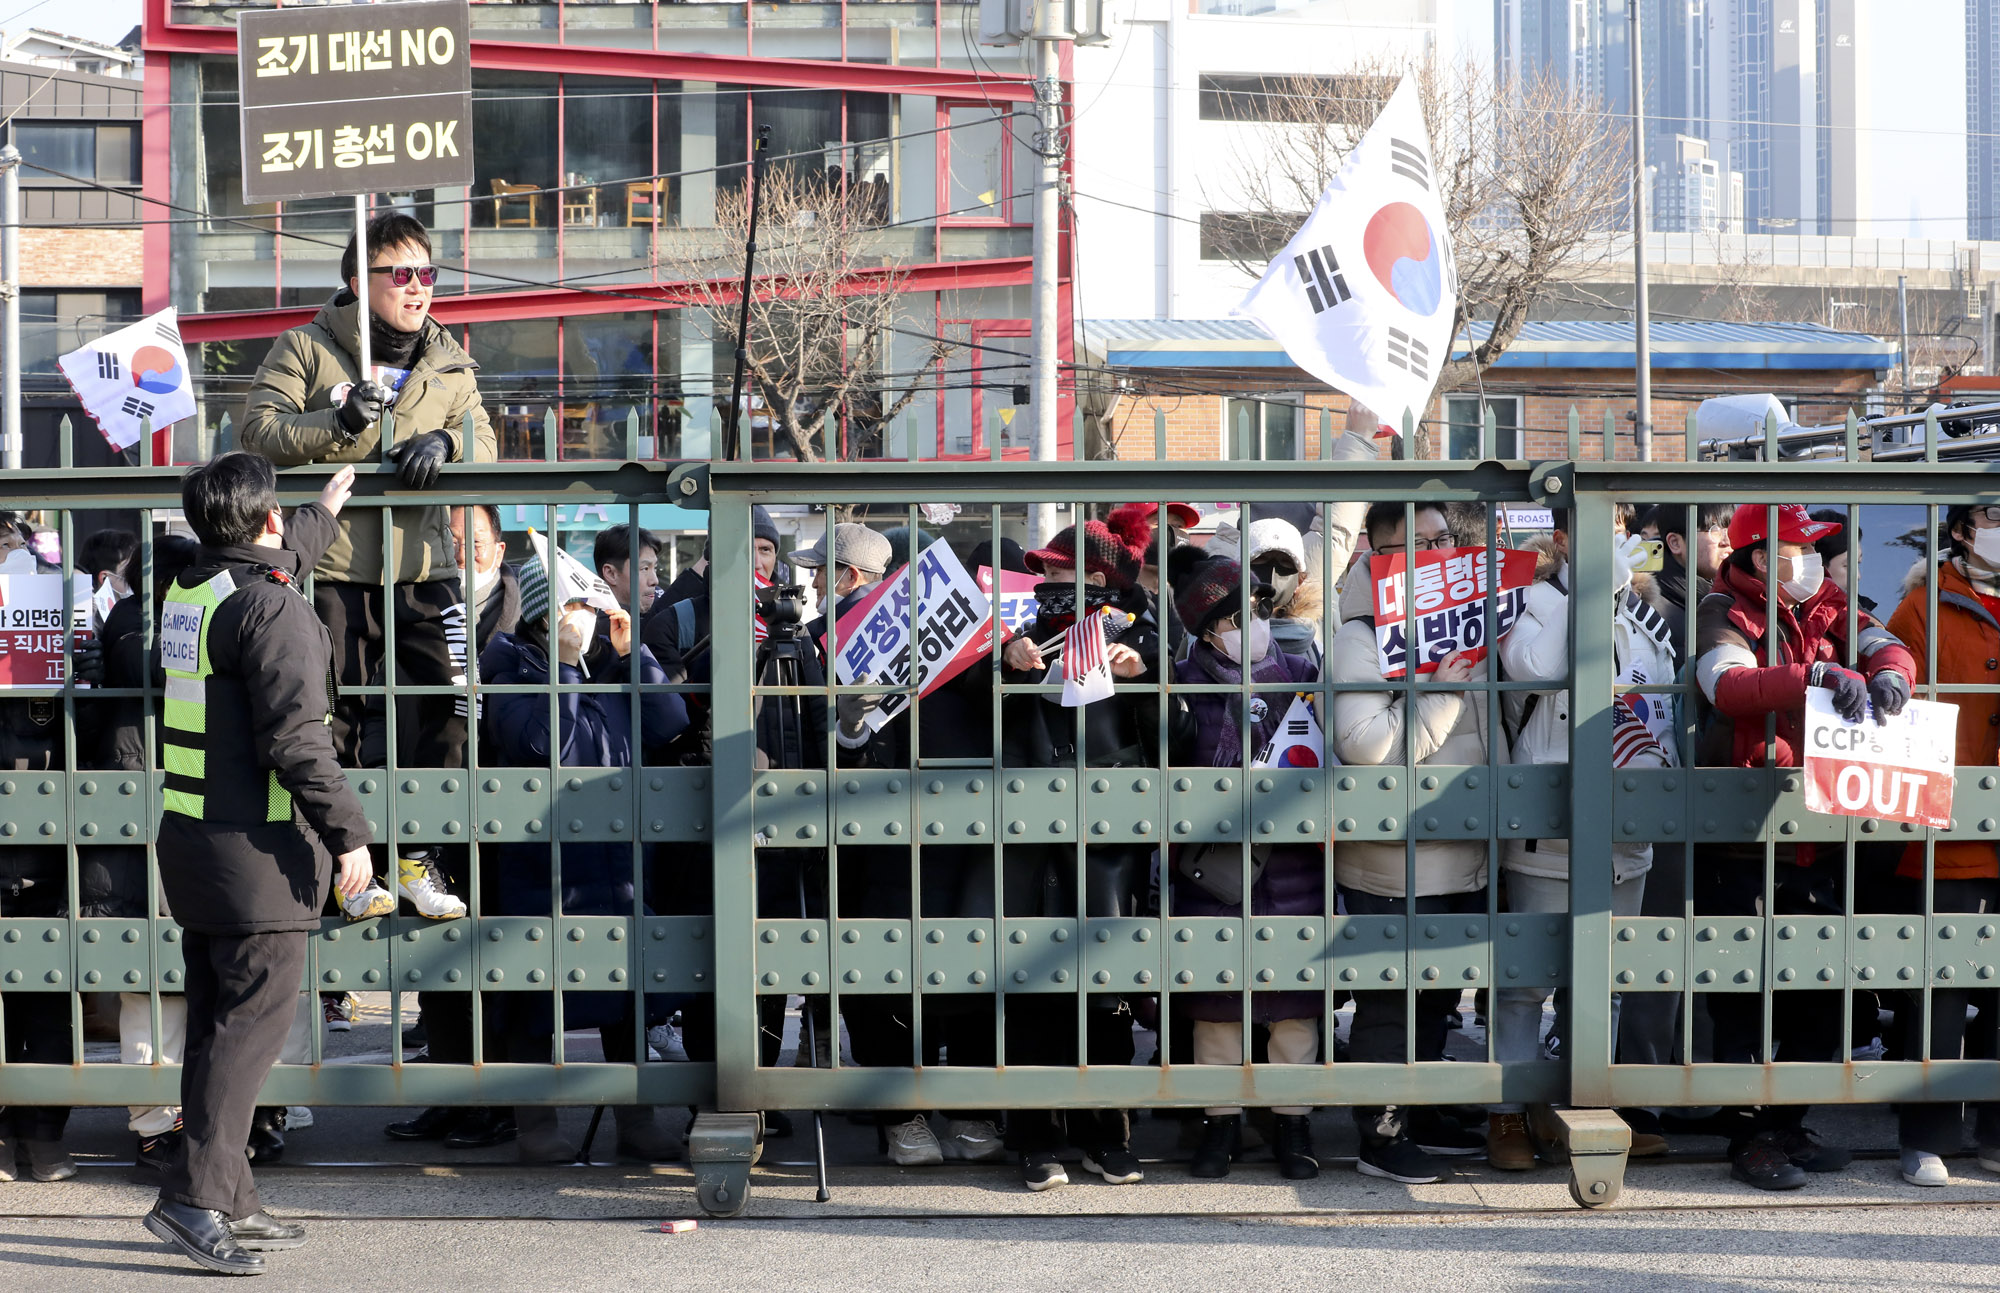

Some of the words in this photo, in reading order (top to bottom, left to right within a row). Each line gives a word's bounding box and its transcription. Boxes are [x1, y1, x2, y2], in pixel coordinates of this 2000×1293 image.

[256, 34, 320, 78] 조기
[328, 29, 393, 72] 대선
[400, 26, 455, 67] NO
[261, 129, 324, 173] 조기
[332, 123, 395, 168] 총선
[405, 120, 460, 161] OK
[1377, 550, 1506, 617] 대통령을
[163, 612, 198, 632] CAMPUS
[845, 549, 951, 680] 부정선거
[1382, 586, 1528, 669] 석방하라
[162, 640, 195, 660] POLICE
[1813, 725, 1865, 752] CCP
[1836, 765, 1928, 818] OUT
